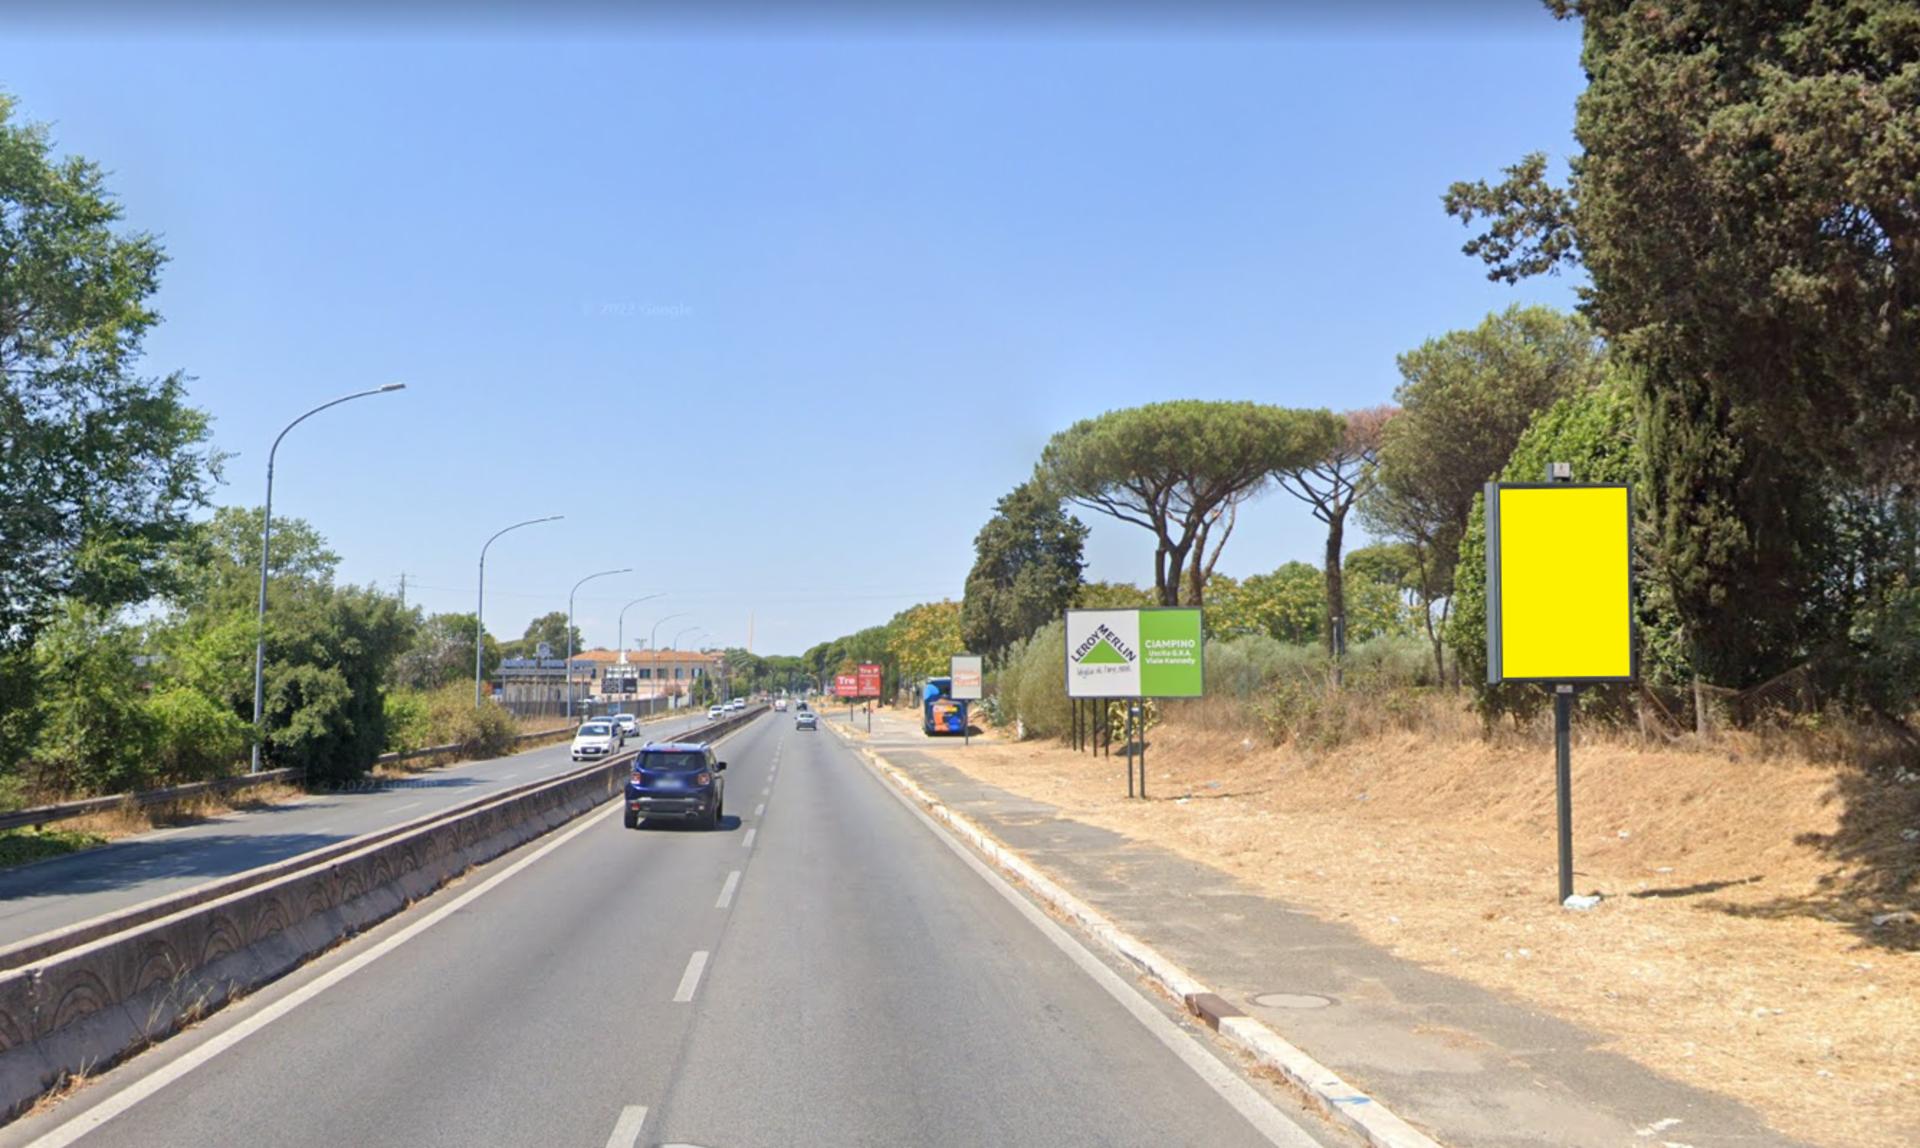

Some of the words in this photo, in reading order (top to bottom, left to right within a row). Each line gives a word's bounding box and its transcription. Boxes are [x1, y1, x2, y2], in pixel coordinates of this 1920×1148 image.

[1071, 631, 1100, 662] LEROY
[1097, 623, 1137, 662] MERLIN
[1144, 639, 1195, 648] CIAMPINO
[837, 676, 856, 685] Tre
